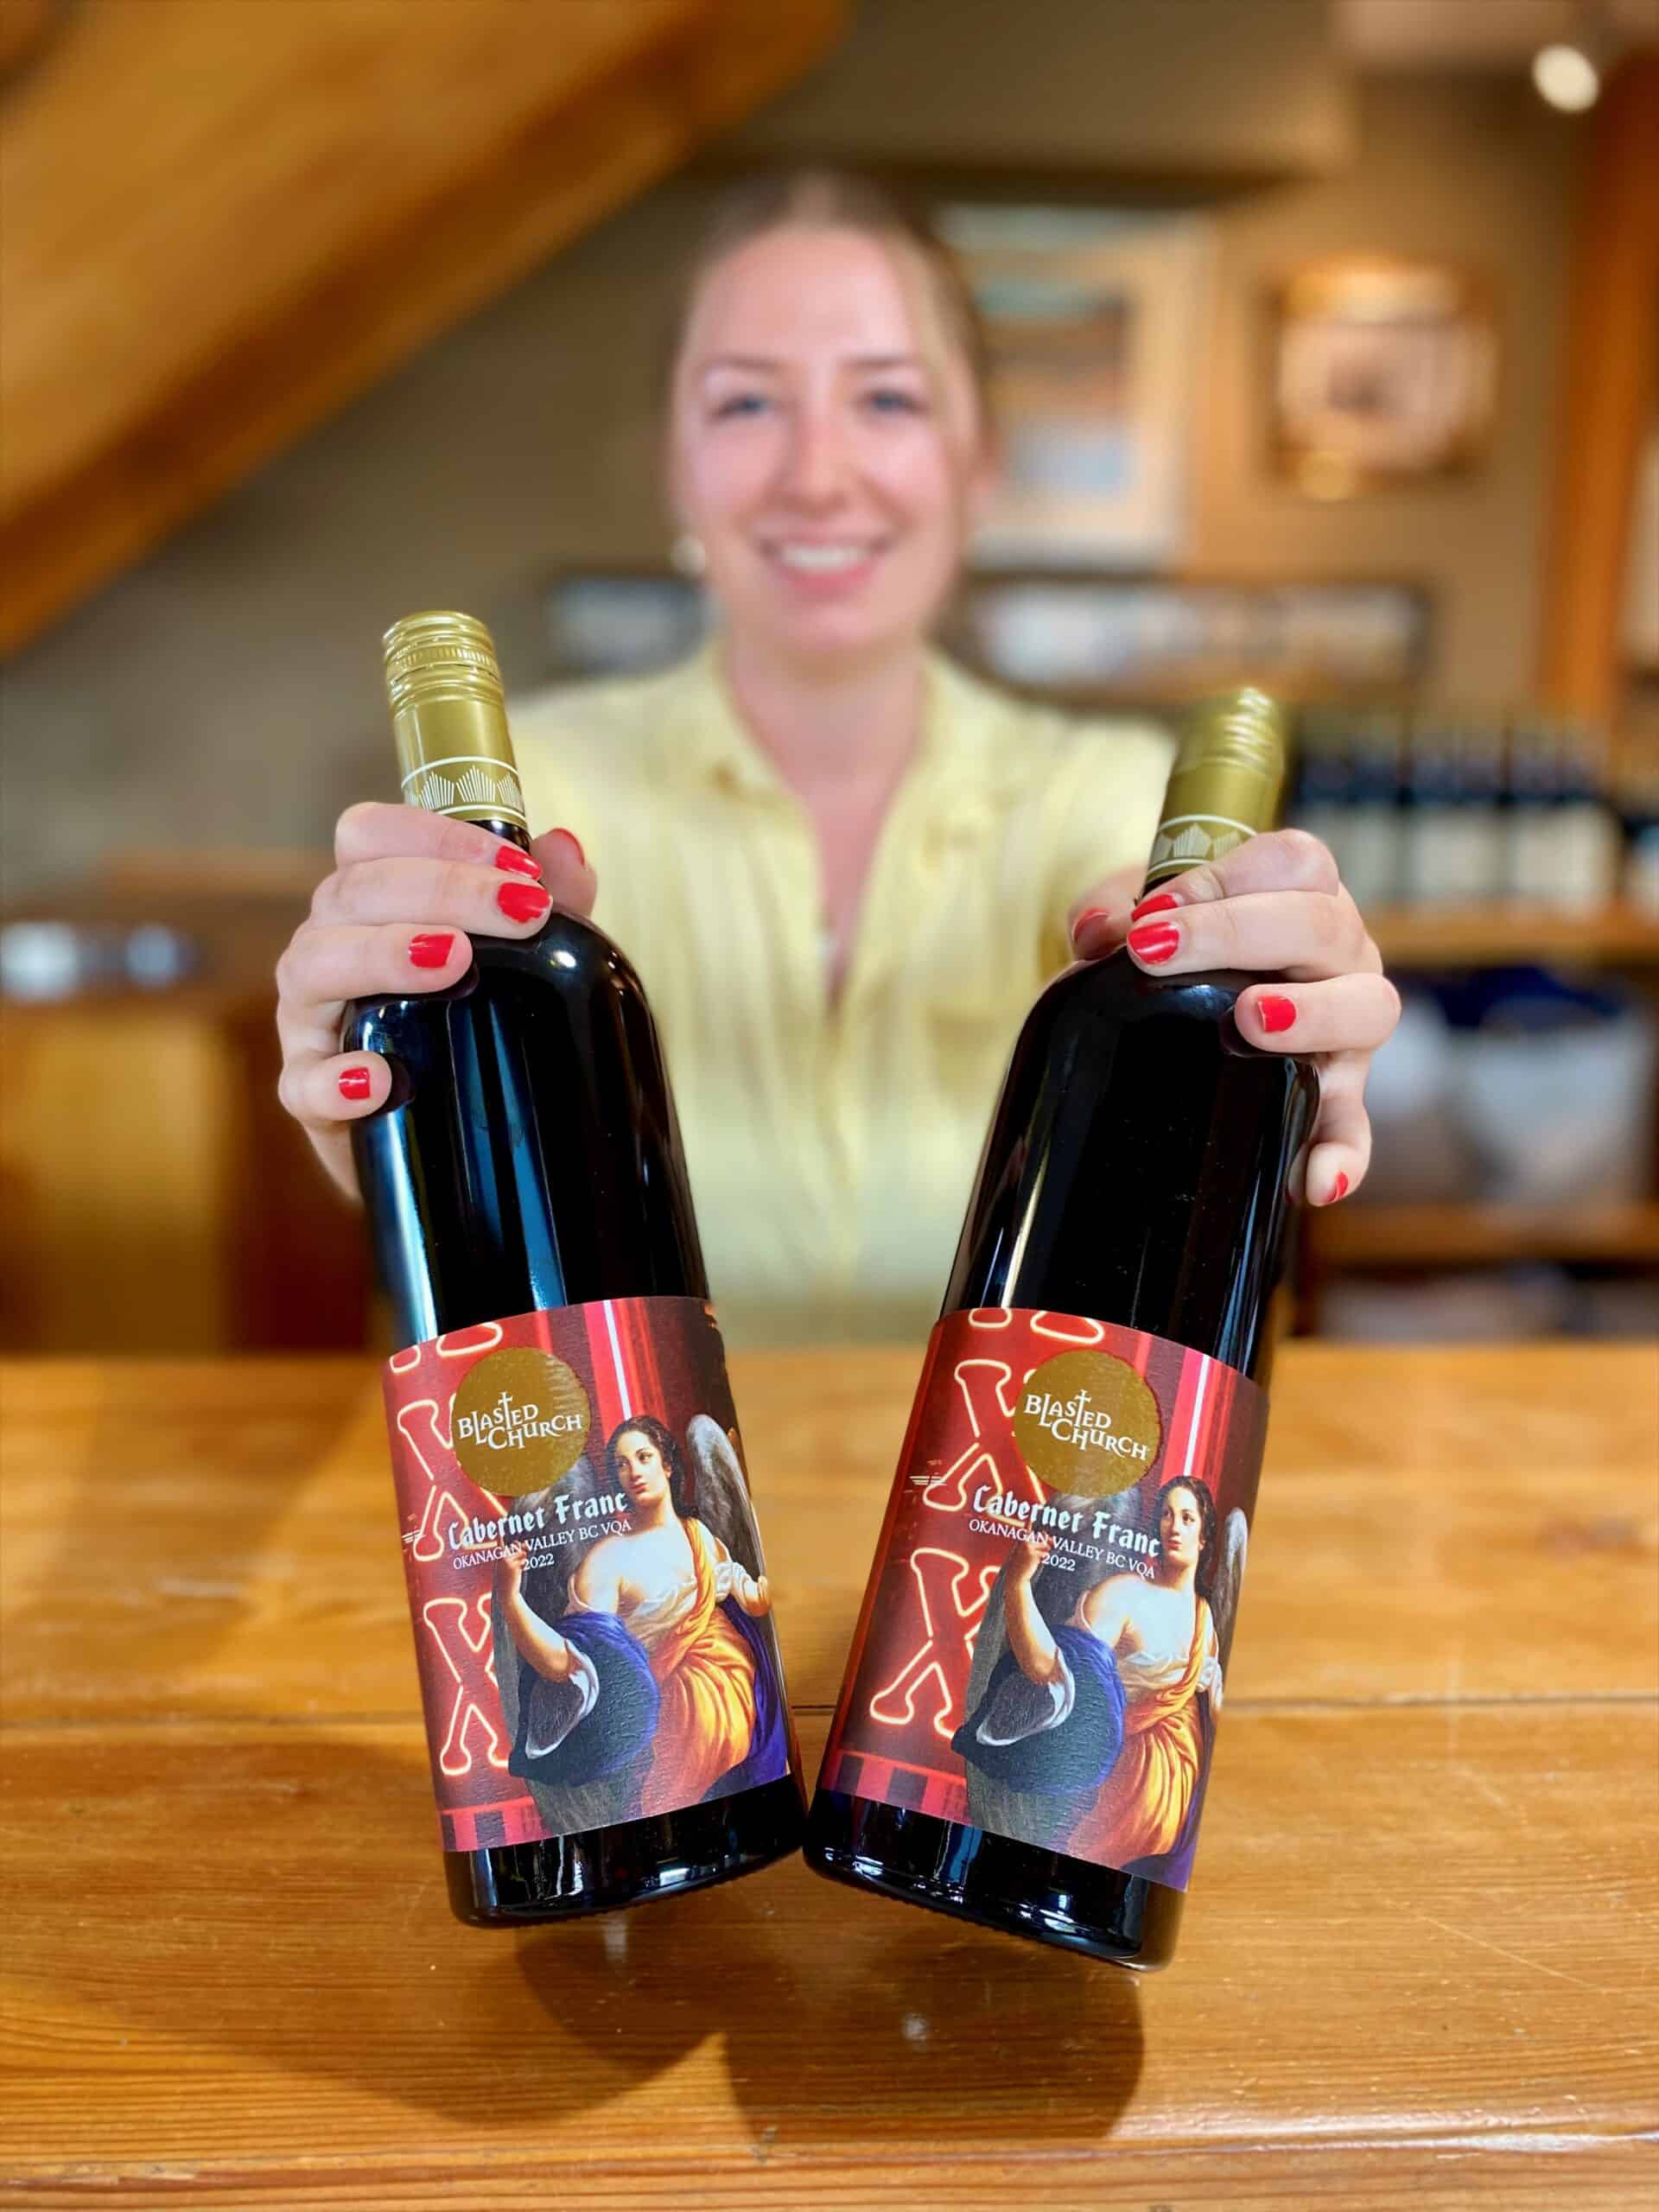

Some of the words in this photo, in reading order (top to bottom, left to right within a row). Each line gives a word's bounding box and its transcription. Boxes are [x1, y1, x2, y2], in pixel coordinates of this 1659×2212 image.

[457, 1391, 539, 1446] BLASTED
[488, 1414, 583, 1450] CHURCH
[1023, 1389, 1112, 1429] BLASTED
[1051, 1418, 1148, 1460] CHURCH
[448, 1506, 545, 1551] Cabernet
[554, 1492, 628, 1525] Franc
[453, 1541, 522, 1571] OKANAGAN
[524, 1529, 575, 1553] VALLEY
[578, 1523, 599, 1541] BC
[601, 1519, 632, 1537] VQA
[973, 1485, 1084, 1534] Cabernet
[1092, 1510, 1161, 1559] Franc
[523, 1552, 555, 1571] 2022
[968, 1518, 1049, 1548] OKANAGAN
[1052, 1535, 1104, 1560] VALLEY
[1106, 1552, 1126, 1569] BC
[1127, 1558, 1156, 1580] VQA
[1042, 1554, 1077, 1573] 2022
